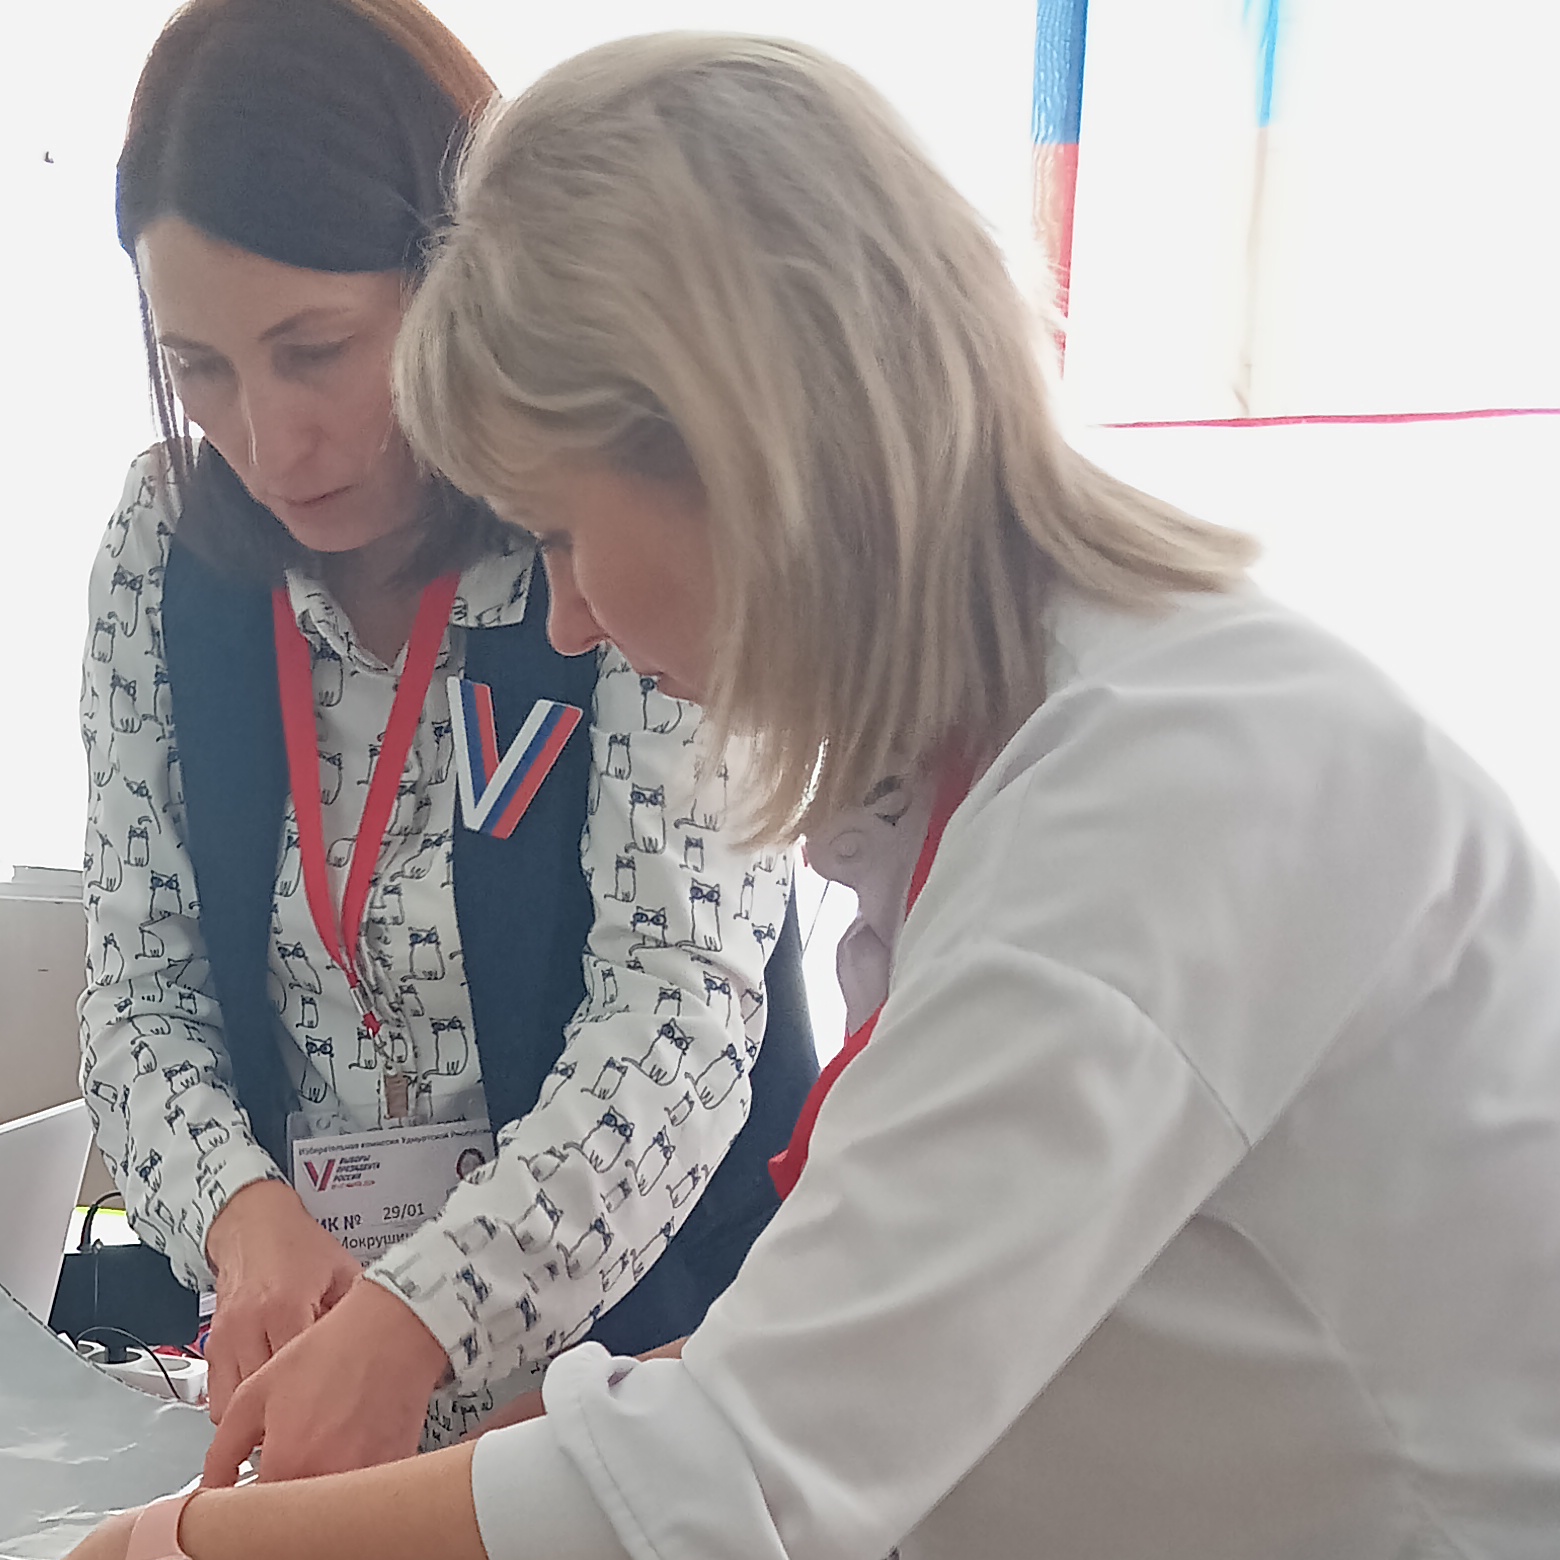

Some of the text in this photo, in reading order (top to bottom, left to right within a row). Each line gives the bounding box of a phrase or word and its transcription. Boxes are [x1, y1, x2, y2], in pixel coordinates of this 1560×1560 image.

[316, 1203, 424, 1232] ИК № 29/01
